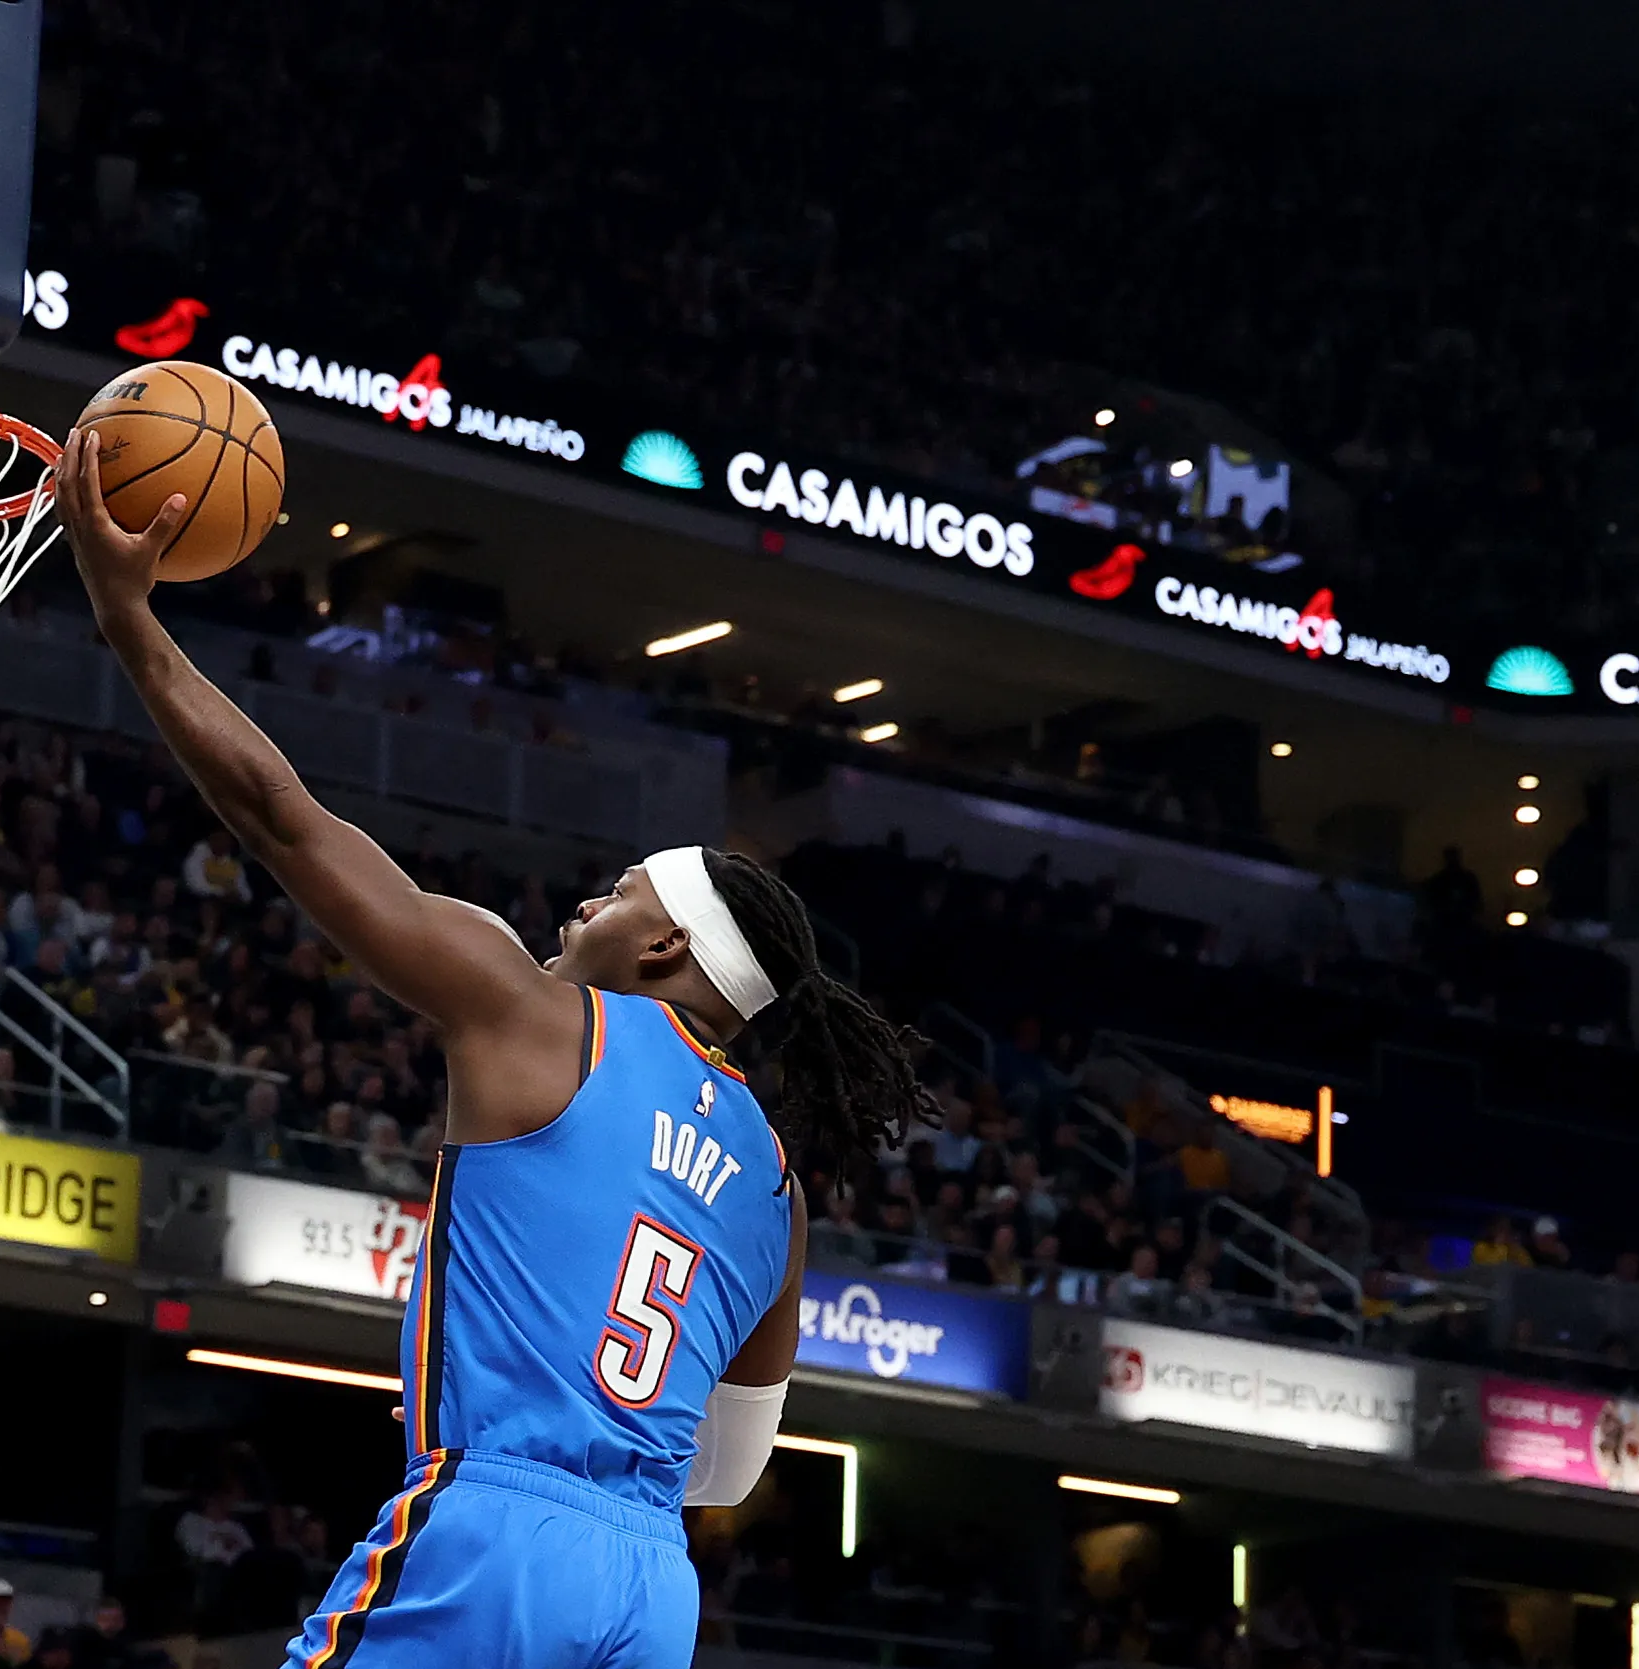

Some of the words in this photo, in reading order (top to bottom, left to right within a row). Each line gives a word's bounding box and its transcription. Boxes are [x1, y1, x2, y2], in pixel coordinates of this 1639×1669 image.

[223, 335, 452, 430] CASAMIGOS
[456, 402, 585, 462] JALAPEÑO
[726, 451, 1034, 577] CASAMIGOS
[1155, 576, 1343, 656] CASAMIGOS
[651, 1110, 743, 1207] DORT
[593, 1211, 706, 1410] 5
[821, 1284, 945, 1379] Kroger
